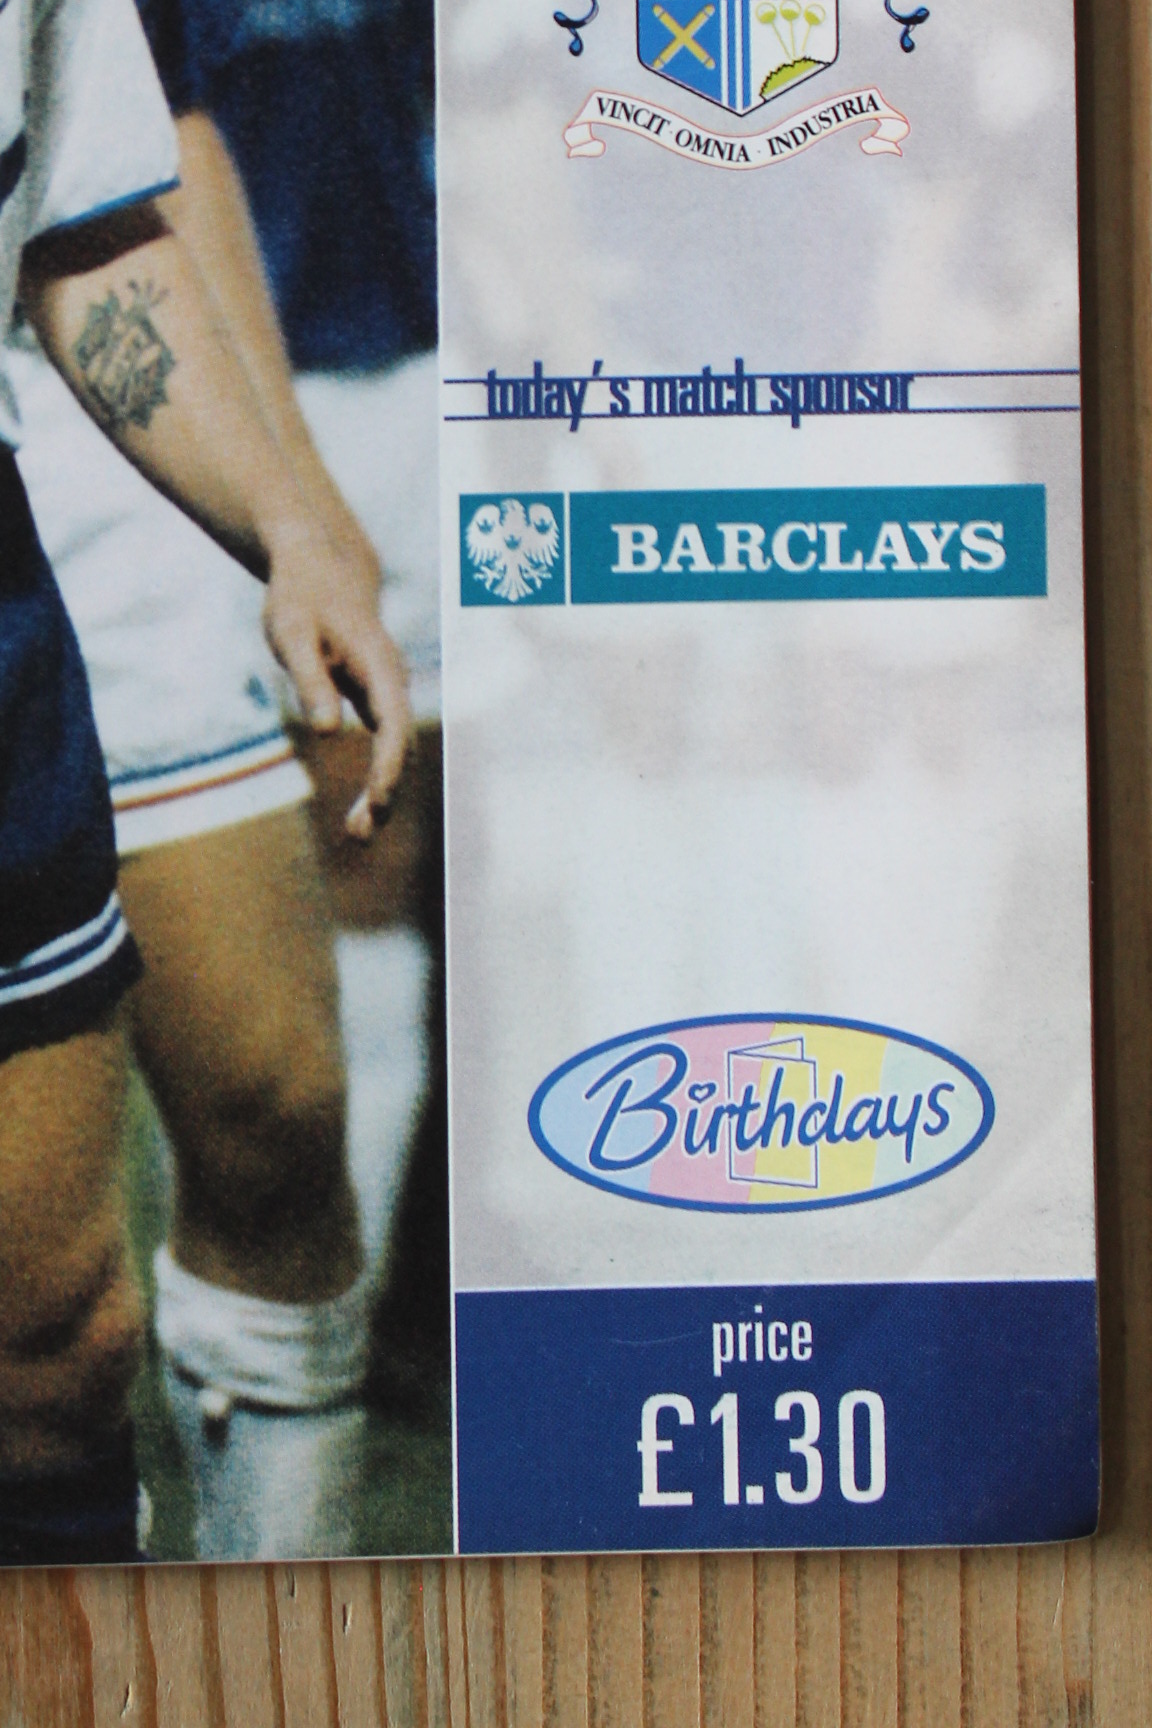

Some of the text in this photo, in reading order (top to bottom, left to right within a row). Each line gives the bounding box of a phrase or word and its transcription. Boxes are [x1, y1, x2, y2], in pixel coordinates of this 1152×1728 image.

[596, 93, 882, 164] VINCIT OMNIA INDUSTRIA
[646, 357, 757, 417] match
[770, 372, 915, 429] sponsor
[610, 519, 1007, 574] BARCLAYS
[584, 1042, 956, 1172] Birthdays
[712, 1305, 814, 1378] price
[636, 1388, 888, 1508] £1.30
